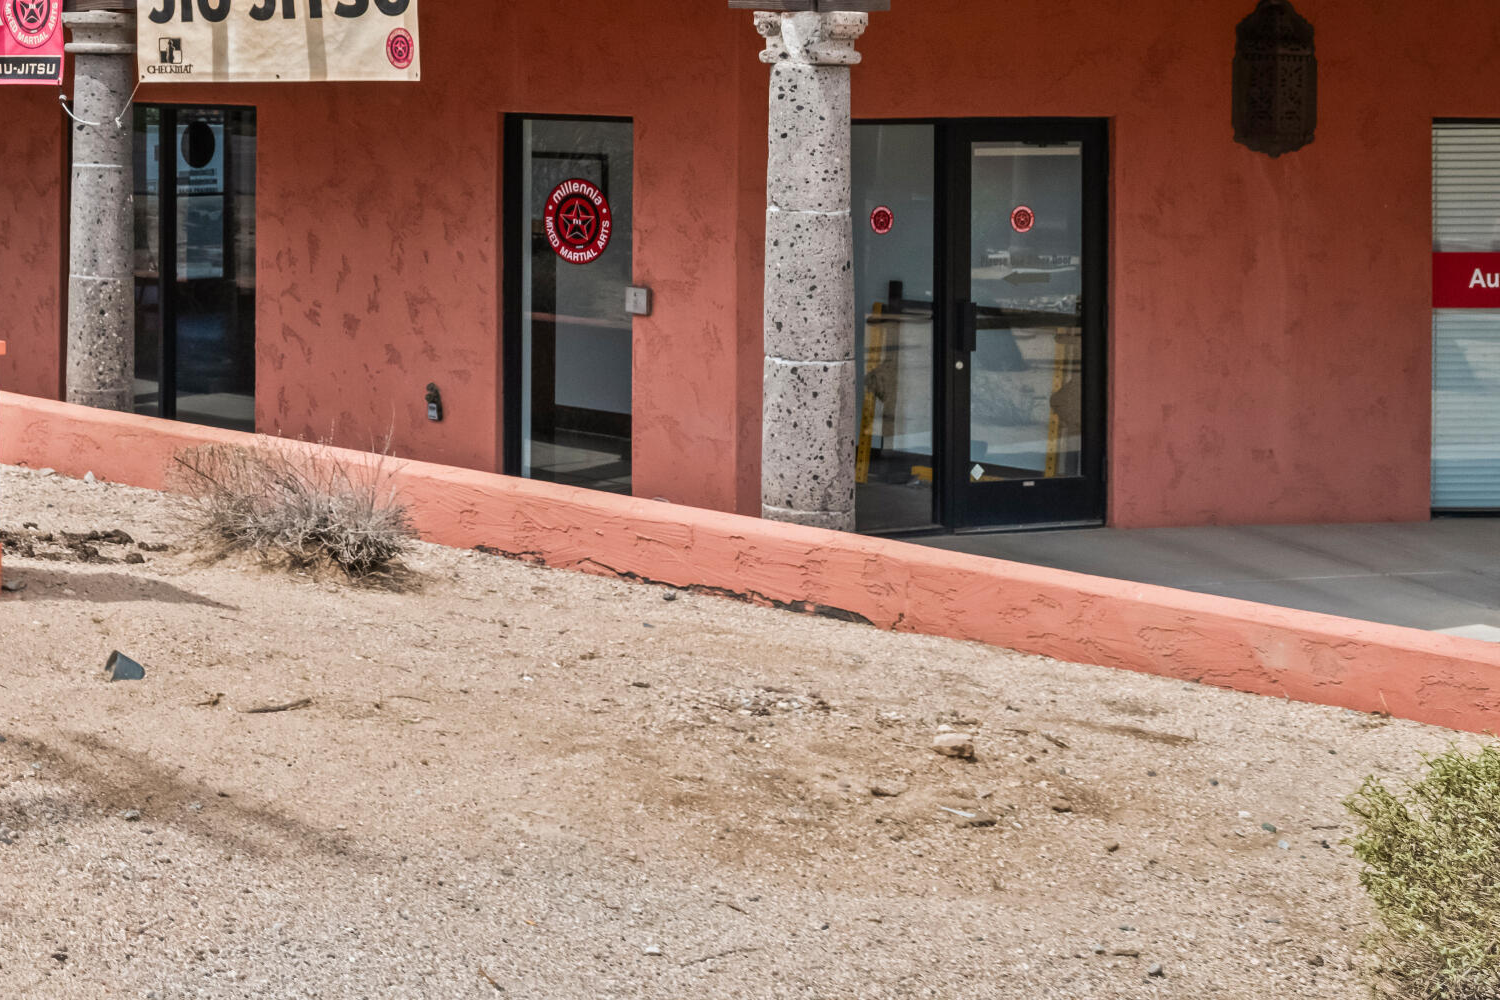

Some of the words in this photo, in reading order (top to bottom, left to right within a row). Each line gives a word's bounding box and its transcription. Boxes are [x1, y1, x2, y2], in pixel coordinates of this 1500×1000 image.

[5, 3, 18, 33] MIXED
[17, 31, 49, 45] MARTIAL
[48, 2, 59, 31] ARTS
[552, 180, 603, 206] millennia
[545, 216, 560, 248] MIXED
[559, 246, 598, 262] MARTIAL
[596, 220, 611, 249] ARTS
